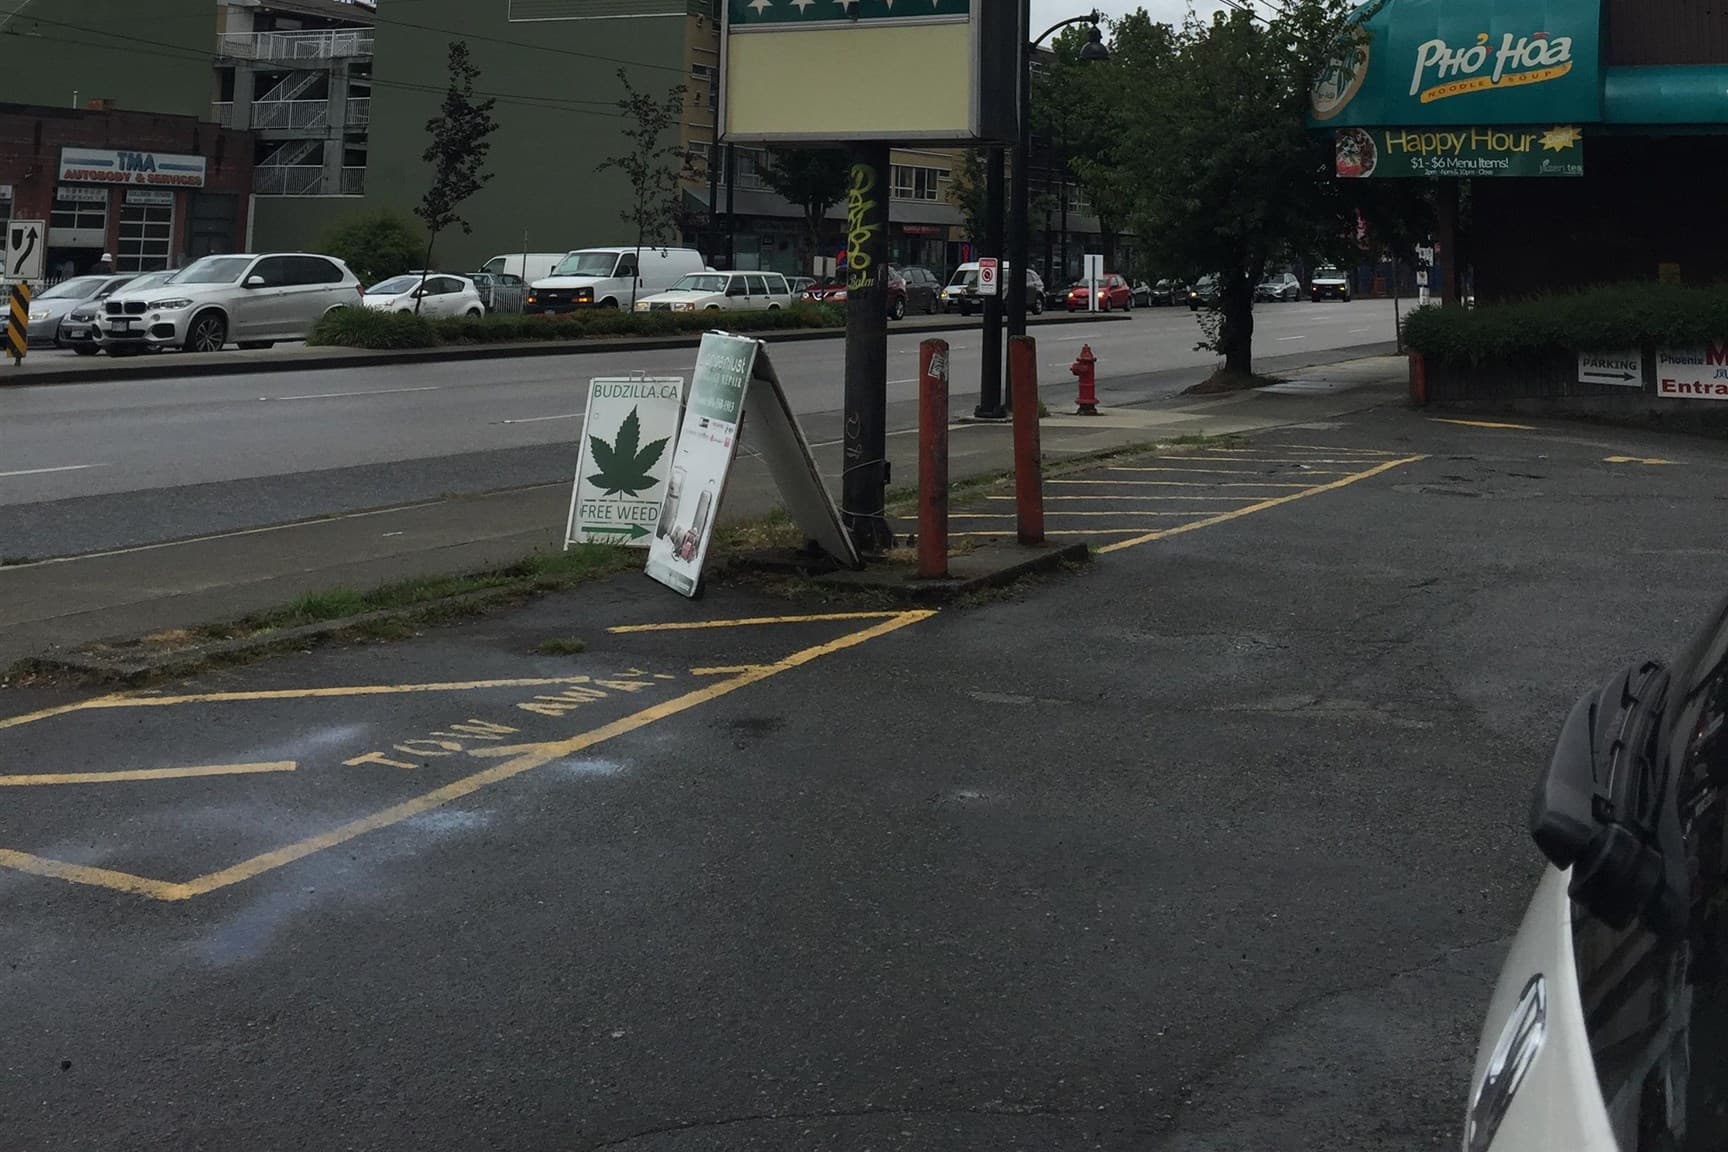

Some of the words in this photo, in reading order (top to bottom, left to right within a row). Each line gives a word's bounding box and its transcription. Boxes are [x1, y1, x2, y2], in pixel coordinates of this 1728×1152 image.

[1428, 80, 1485, 98] NOODLE
[1508, 70, 1553, 83] SOUP
[1385, 129, 1467, 156] Happy
[1471, 128, 1537, 153] Hour
[117, 151, 156, 172] TMA
[1410, 157, 1423, 169] $1
[1431, 156, 1446, 169] $6
[1447, 156, 1477, 169] Menu
[1478, 155, 1509, 169] Items!
[64, 169, 131, 182] AUTOBODY
[135, 173, 145, 183] &
[147, 174, 202, 186] SERVICES
[1583, 358, 1638, 371] PARKING
[1660, 352, 1703, 365] Phoenix
[593, 384, 678, 399] BUDZILLA.CA
[1662, 379, 1728, 395] Entra
[580, 504, 613, 519] FREE
[617, 505, 658, 521] WEED
[341, 718, 521, 770] TOW
